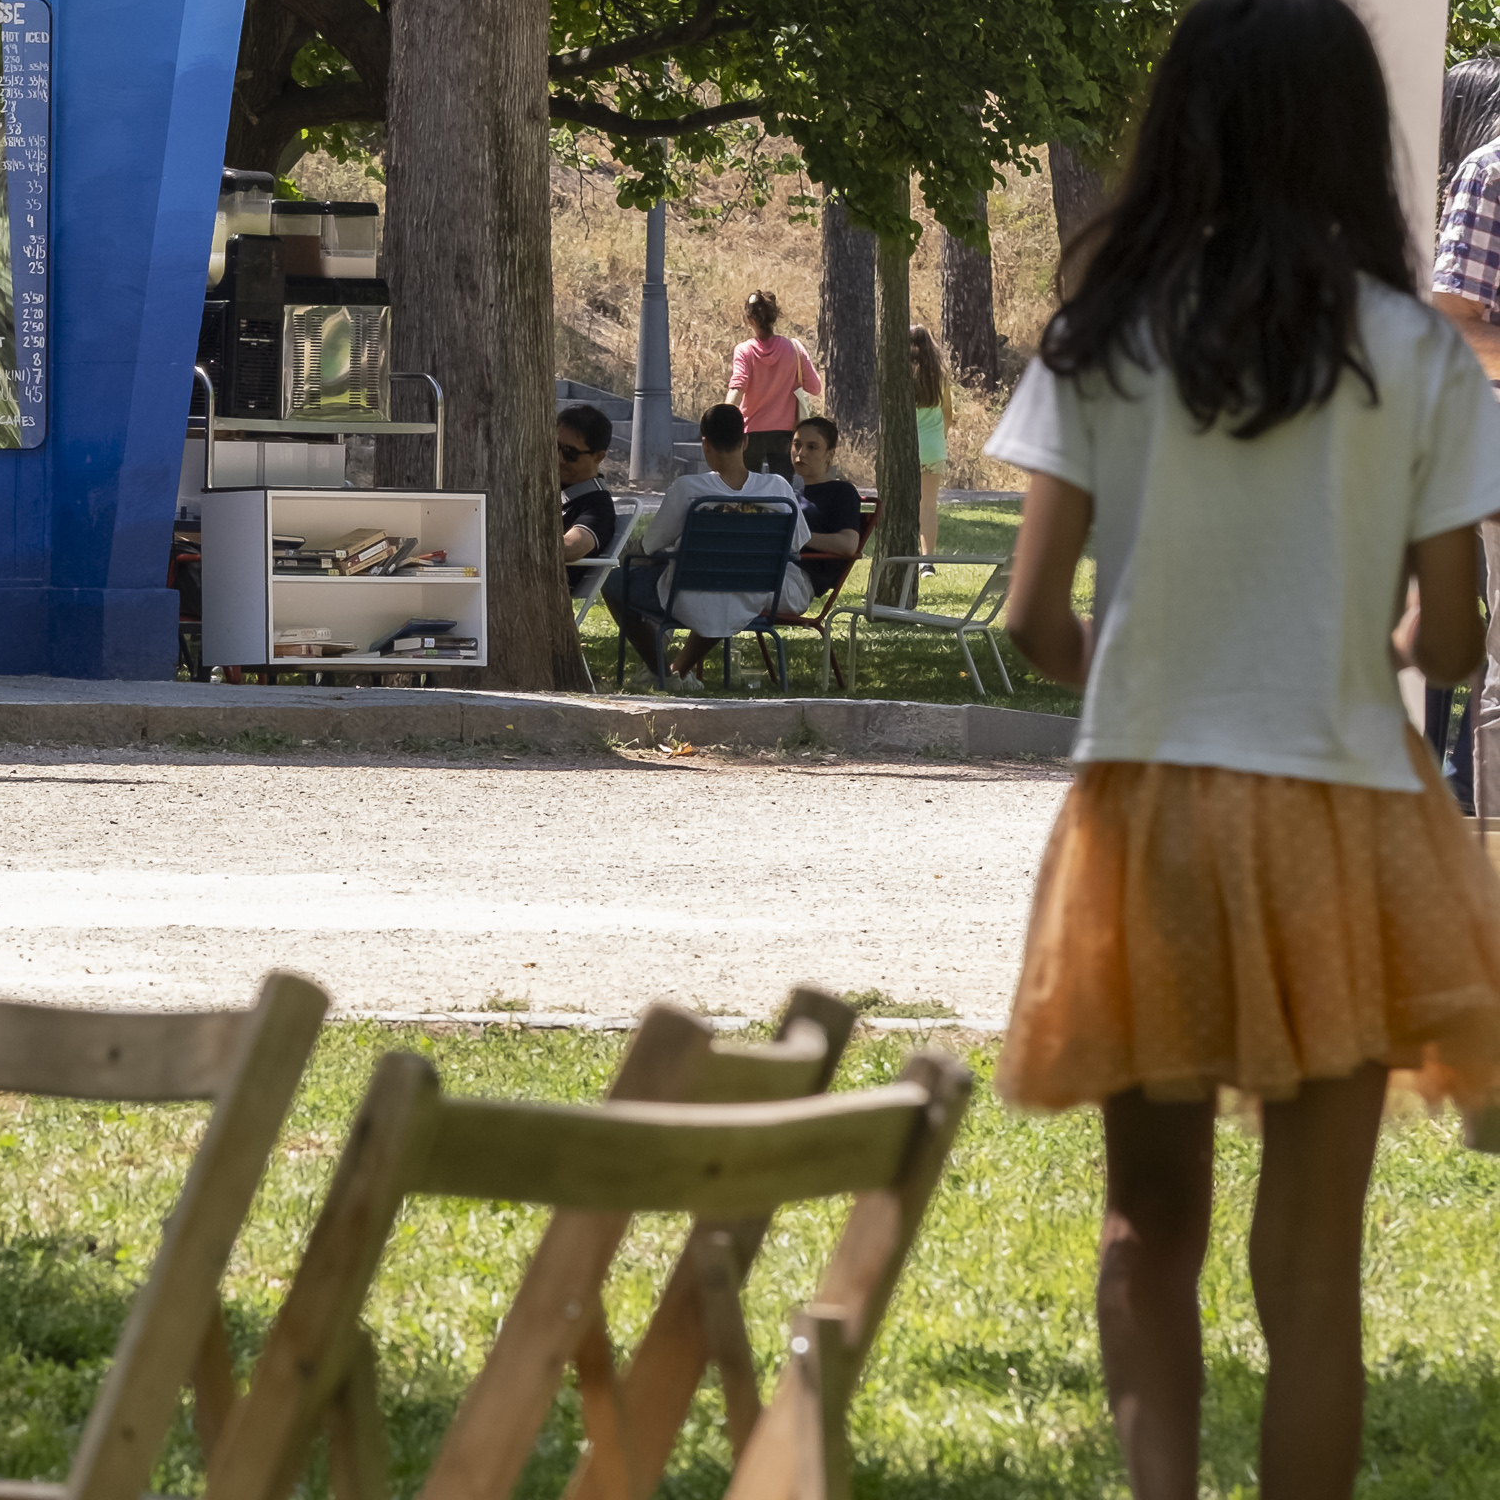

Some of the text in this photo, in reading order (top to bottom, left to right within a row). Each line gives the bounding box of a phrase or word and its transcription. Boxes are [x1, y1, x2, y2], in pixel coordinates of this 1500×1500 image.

[1, 31, 20, 43] HOT
[25, 32, 50, 44] ICED
[7, 113, 18, 124] 3
[26, 214, 34, 228] 4
[33, 352, 42, 366] 8
[32, 368, 44, 384] 7
